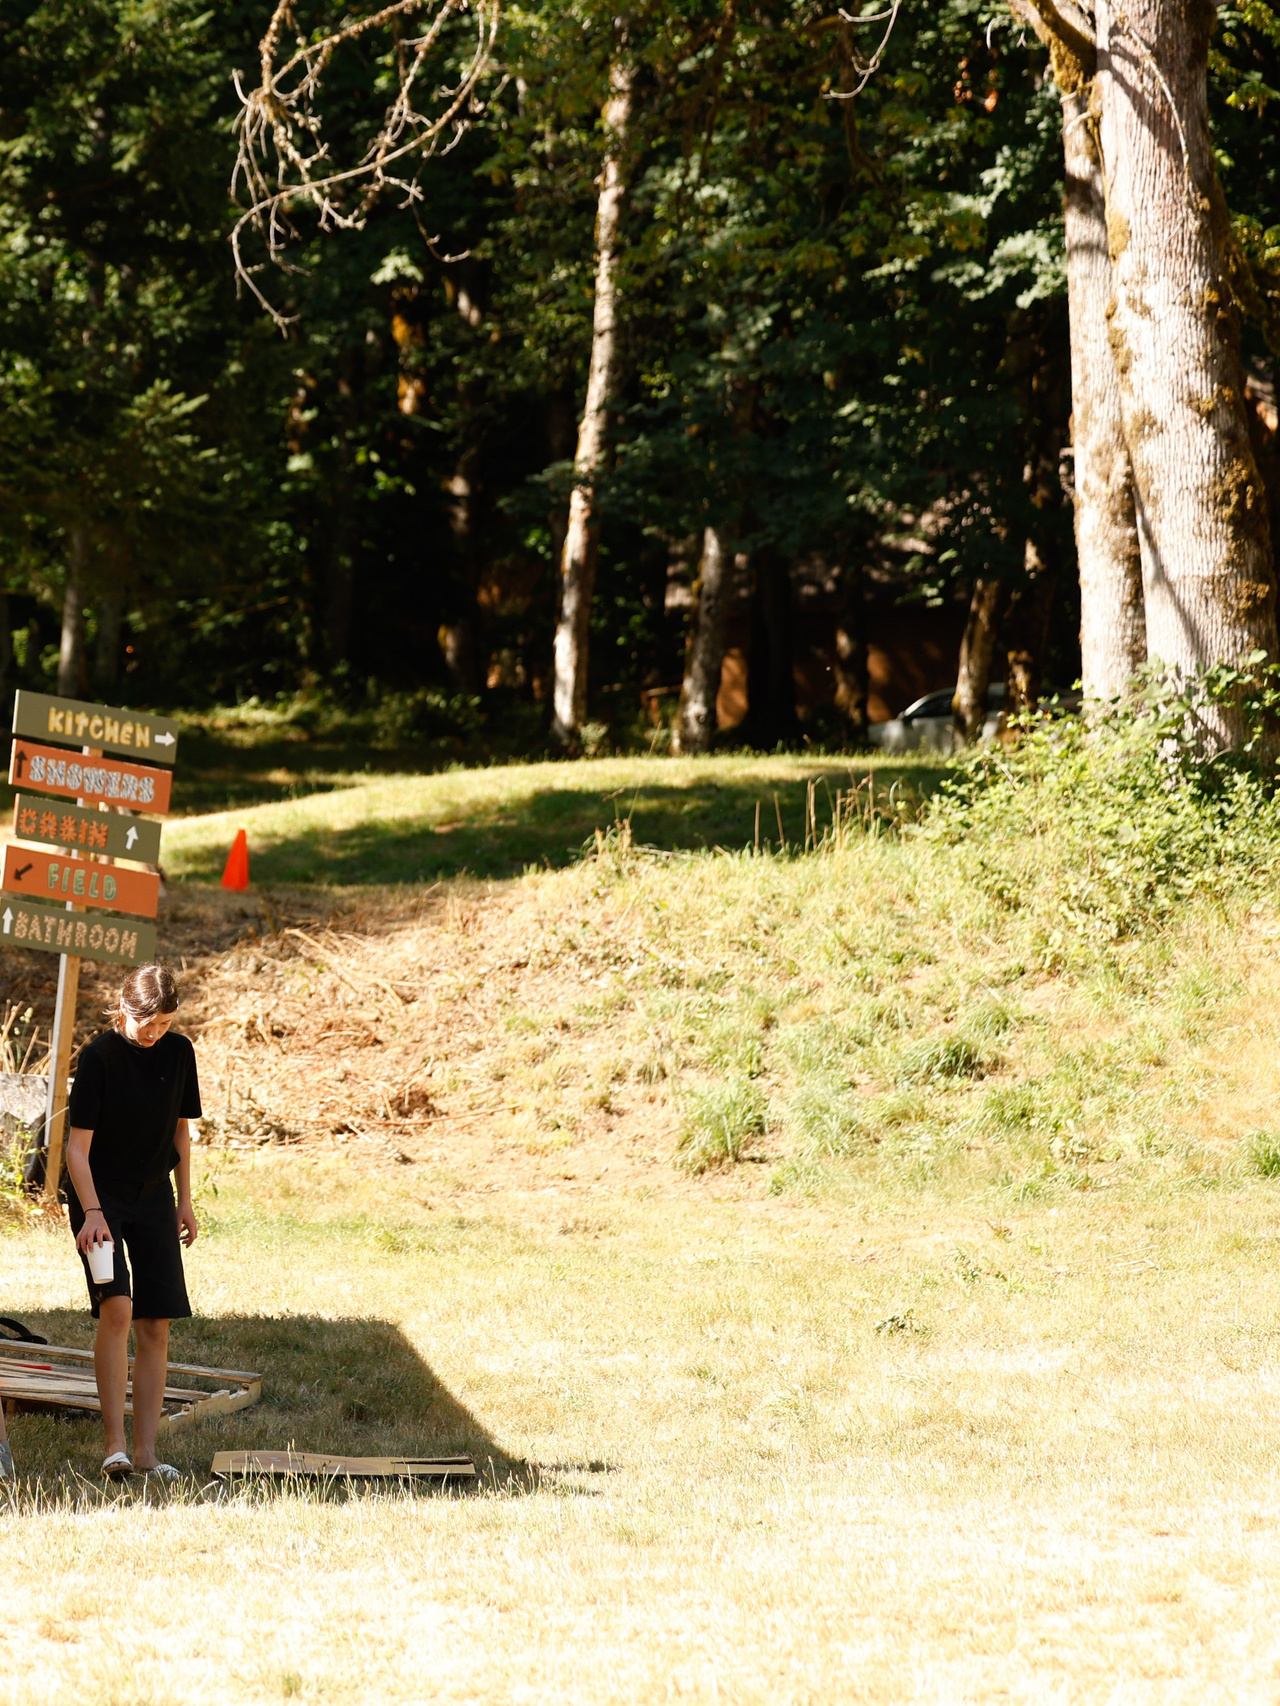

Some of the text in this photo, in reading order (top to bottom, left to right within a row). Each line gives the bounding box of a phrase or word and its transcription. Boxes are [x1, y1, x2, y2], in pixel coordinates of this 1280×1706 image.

[48, 706, 150, 748] KITCHEN
[29, 755, 155, 803] SHOWERS
[19, 808, 109, 848] CABIN
[48, 863, 117, 901] FIELD
[14, 911, 138, 959] BATHROOM
